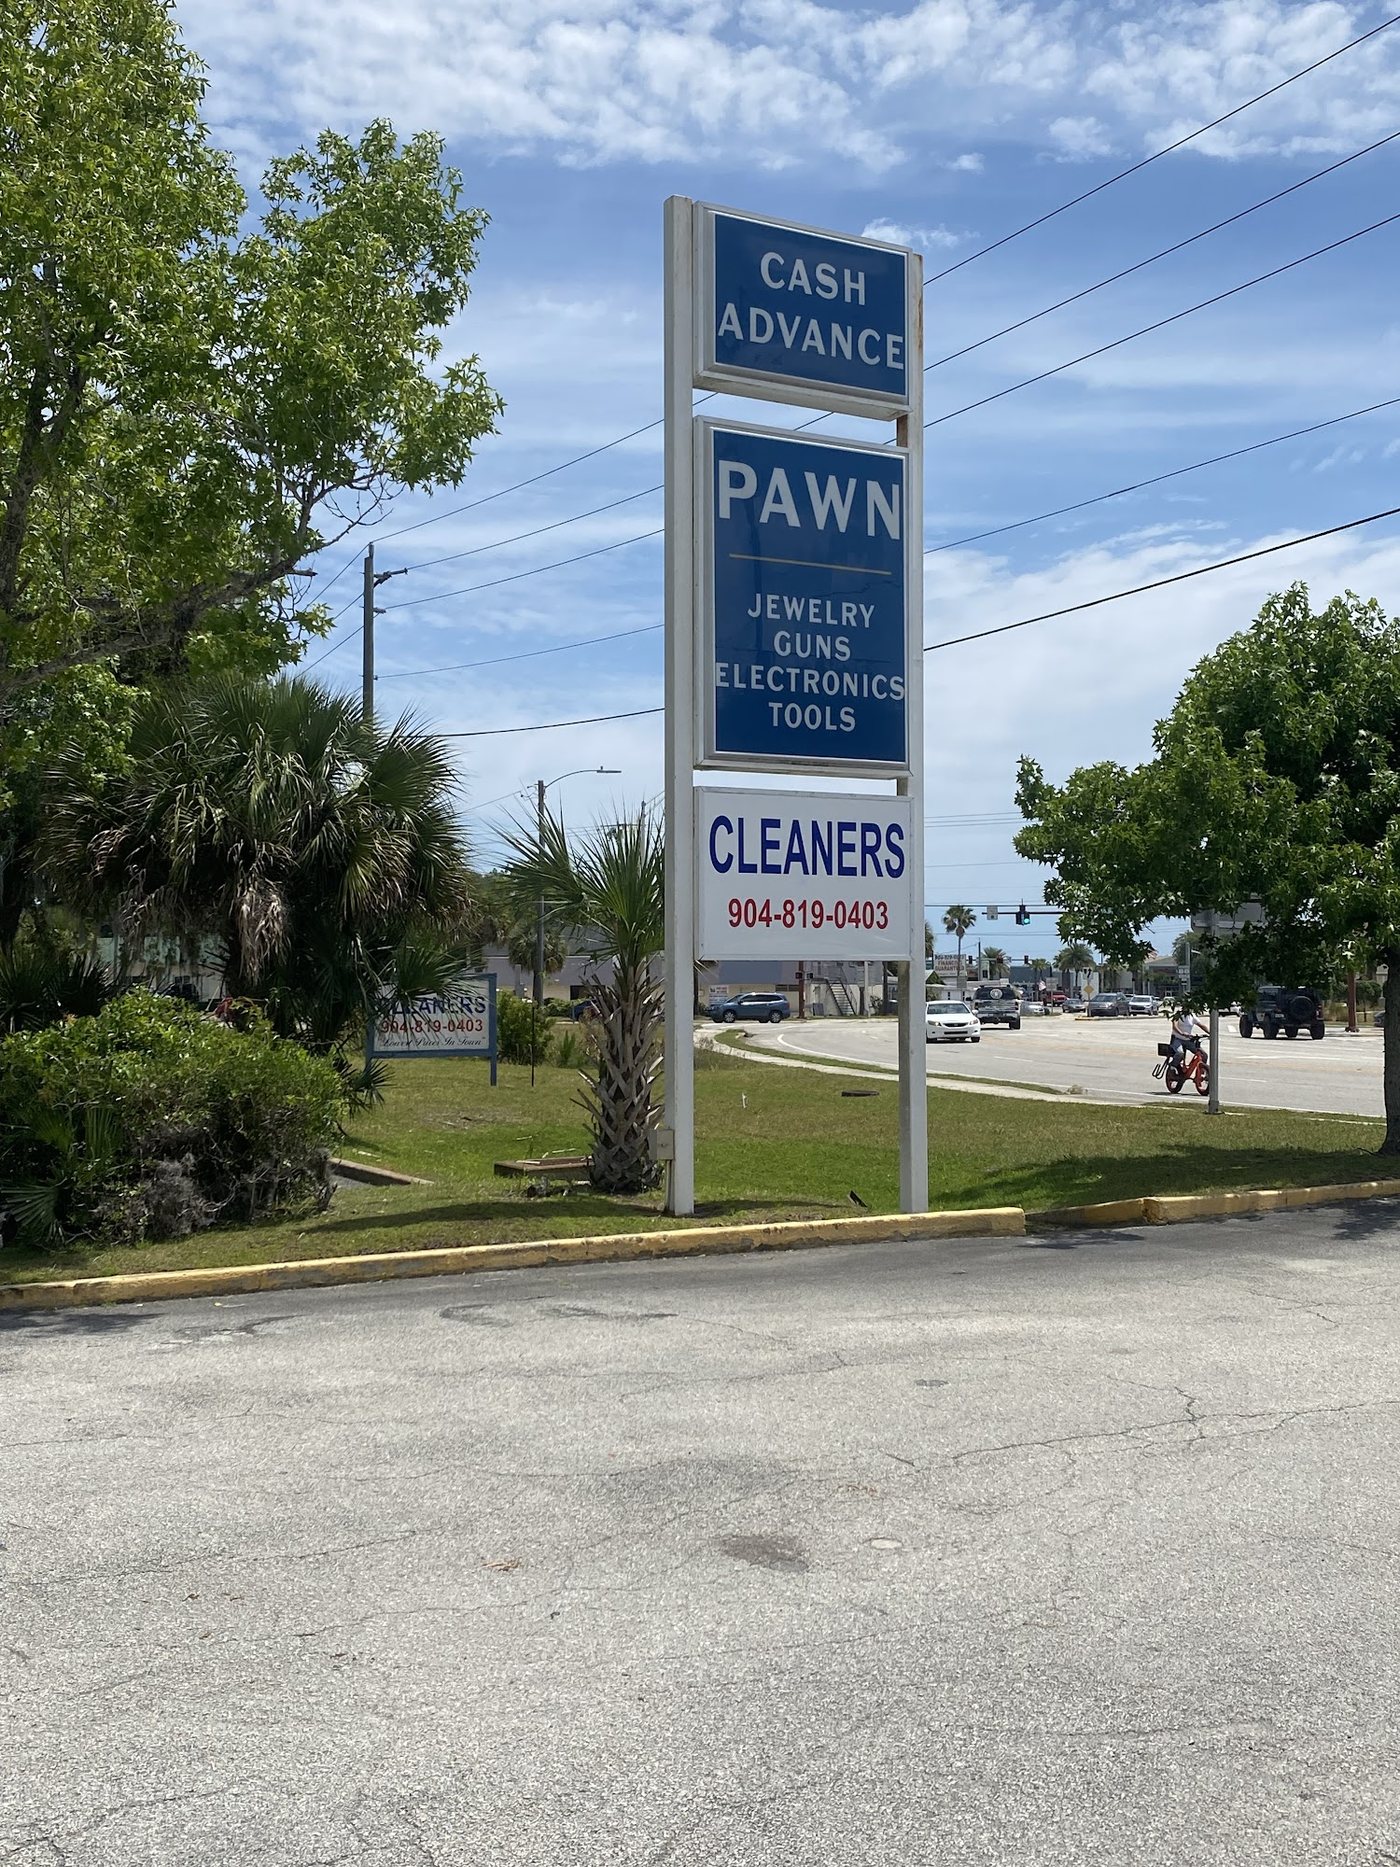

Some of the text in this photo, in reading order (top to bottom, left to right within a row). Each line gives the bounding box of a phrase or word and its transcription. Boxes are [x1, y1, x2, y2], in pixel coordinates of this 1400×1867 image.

[760, 252, 865, 305] CASH
[718, 302, 904, 370] ADVANCE
[718, 459, 900, 540] PAWN
[747, 593, 875, 629] JEWELRY
[773, 630, 851, 662] GUNS
[715, 662, 905, 701] ELECTRONICS
[768, 702, 856, 732] TOOLS
[709, 815, 905, 879] CLEANERS
[728, 898, 889, 930] 904-819-0403
